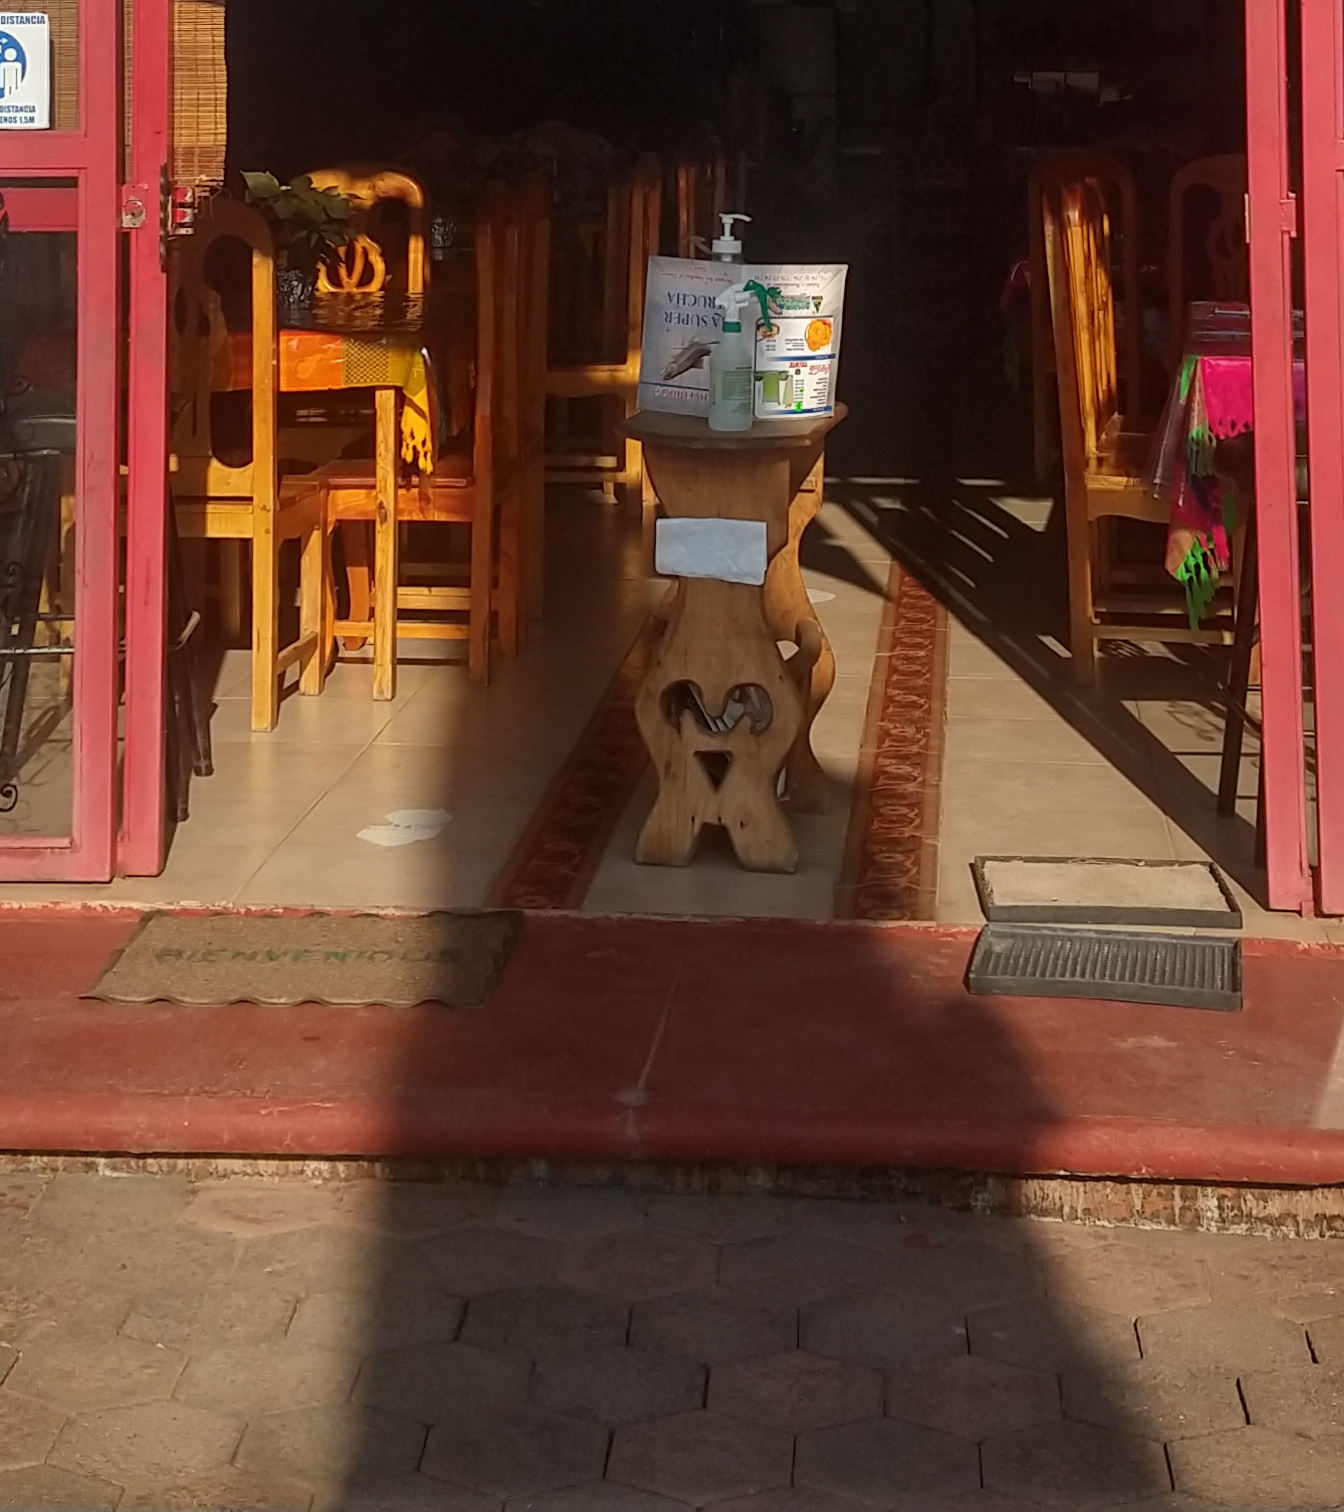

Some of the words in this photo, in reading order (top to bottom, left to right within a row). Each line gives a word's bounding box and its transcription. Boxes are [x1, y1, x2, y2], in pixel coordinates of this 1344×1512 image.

[0, 16, 45, 25] DISTANCIA
[0, 105, 36, 113] DISTANCIA
[664, 311, 708, 328] SUPER
